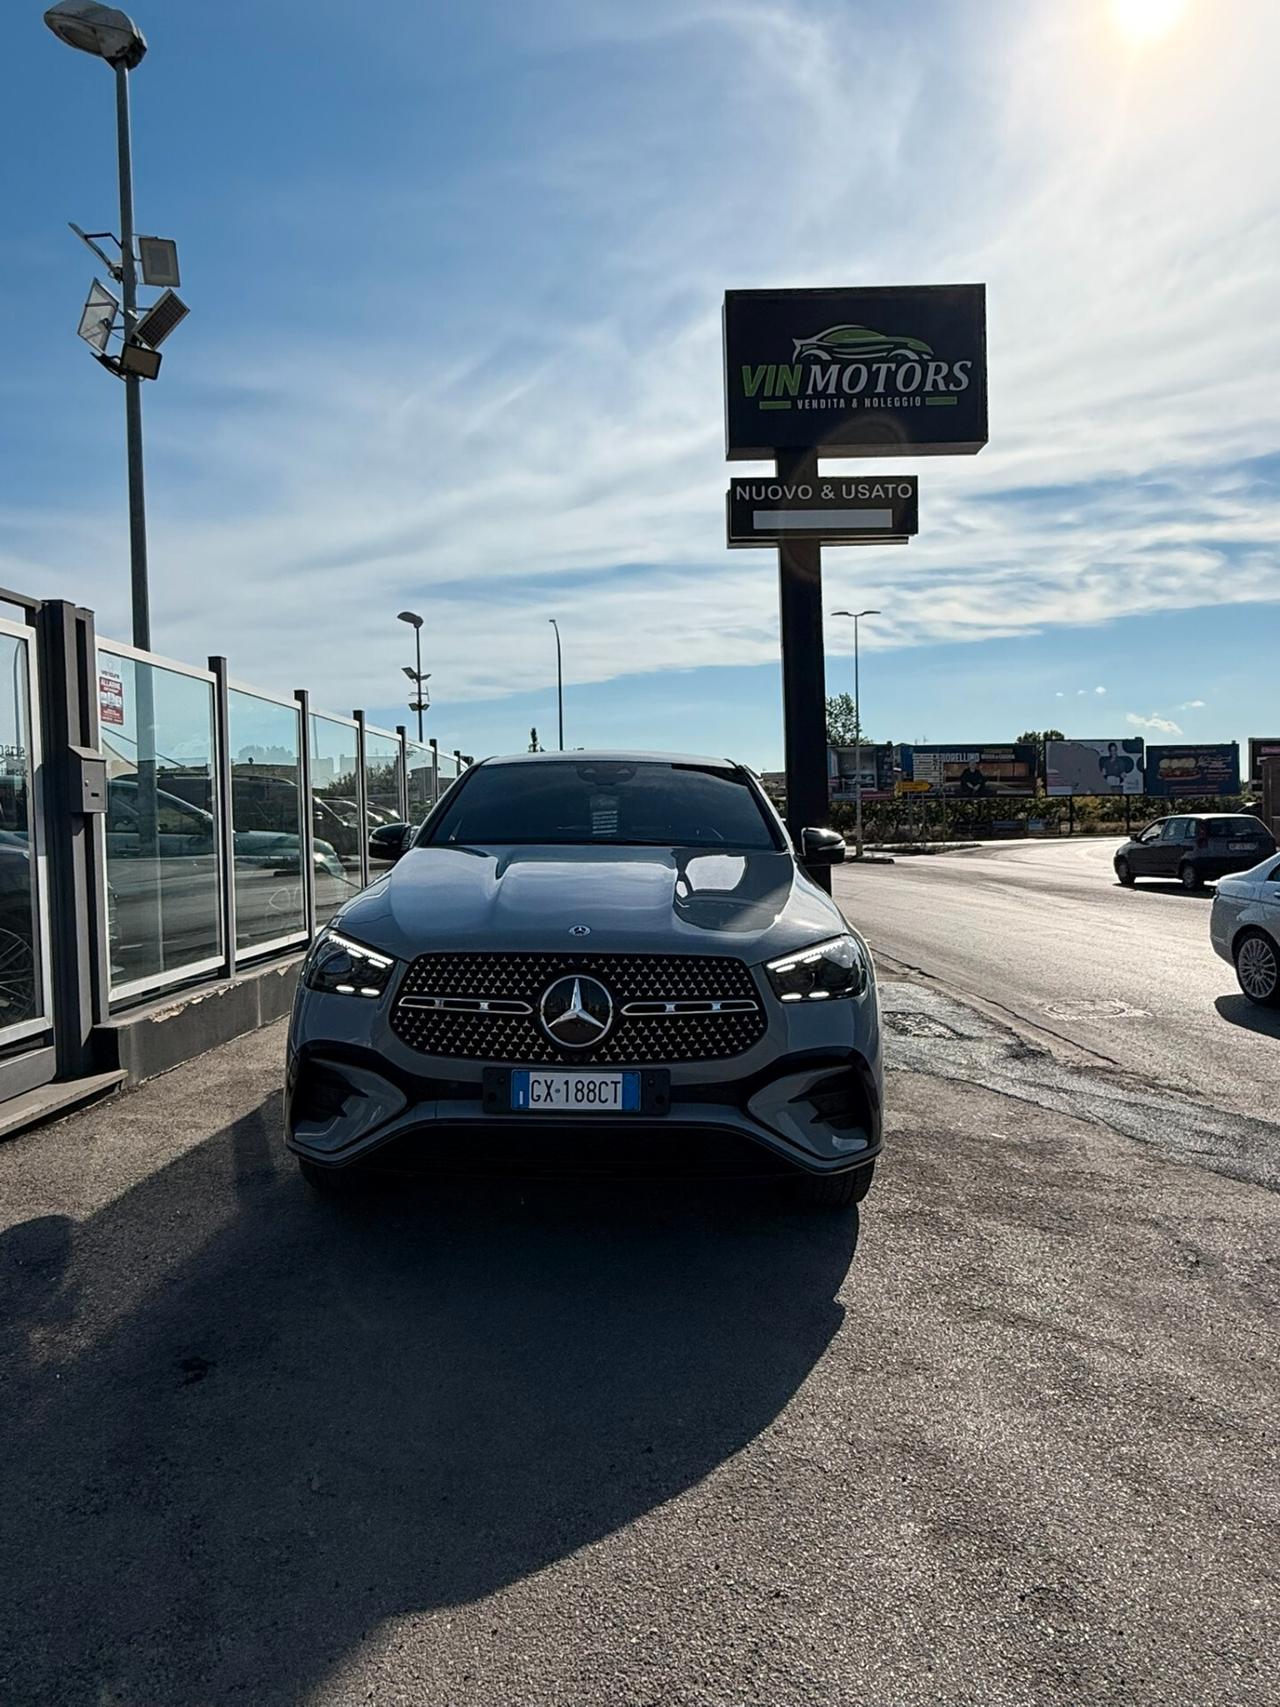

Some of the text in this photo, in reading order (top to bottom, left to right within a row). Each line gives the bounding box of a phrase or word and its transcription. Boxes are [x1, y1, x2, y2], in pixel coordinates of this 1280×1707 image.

[741, 361, 972, 397] VIN MOTORS
[797, 397, 922, 410] VENDITA & NOLEGGIO
[736, 483, 913, 501] NUOVO & USATO
